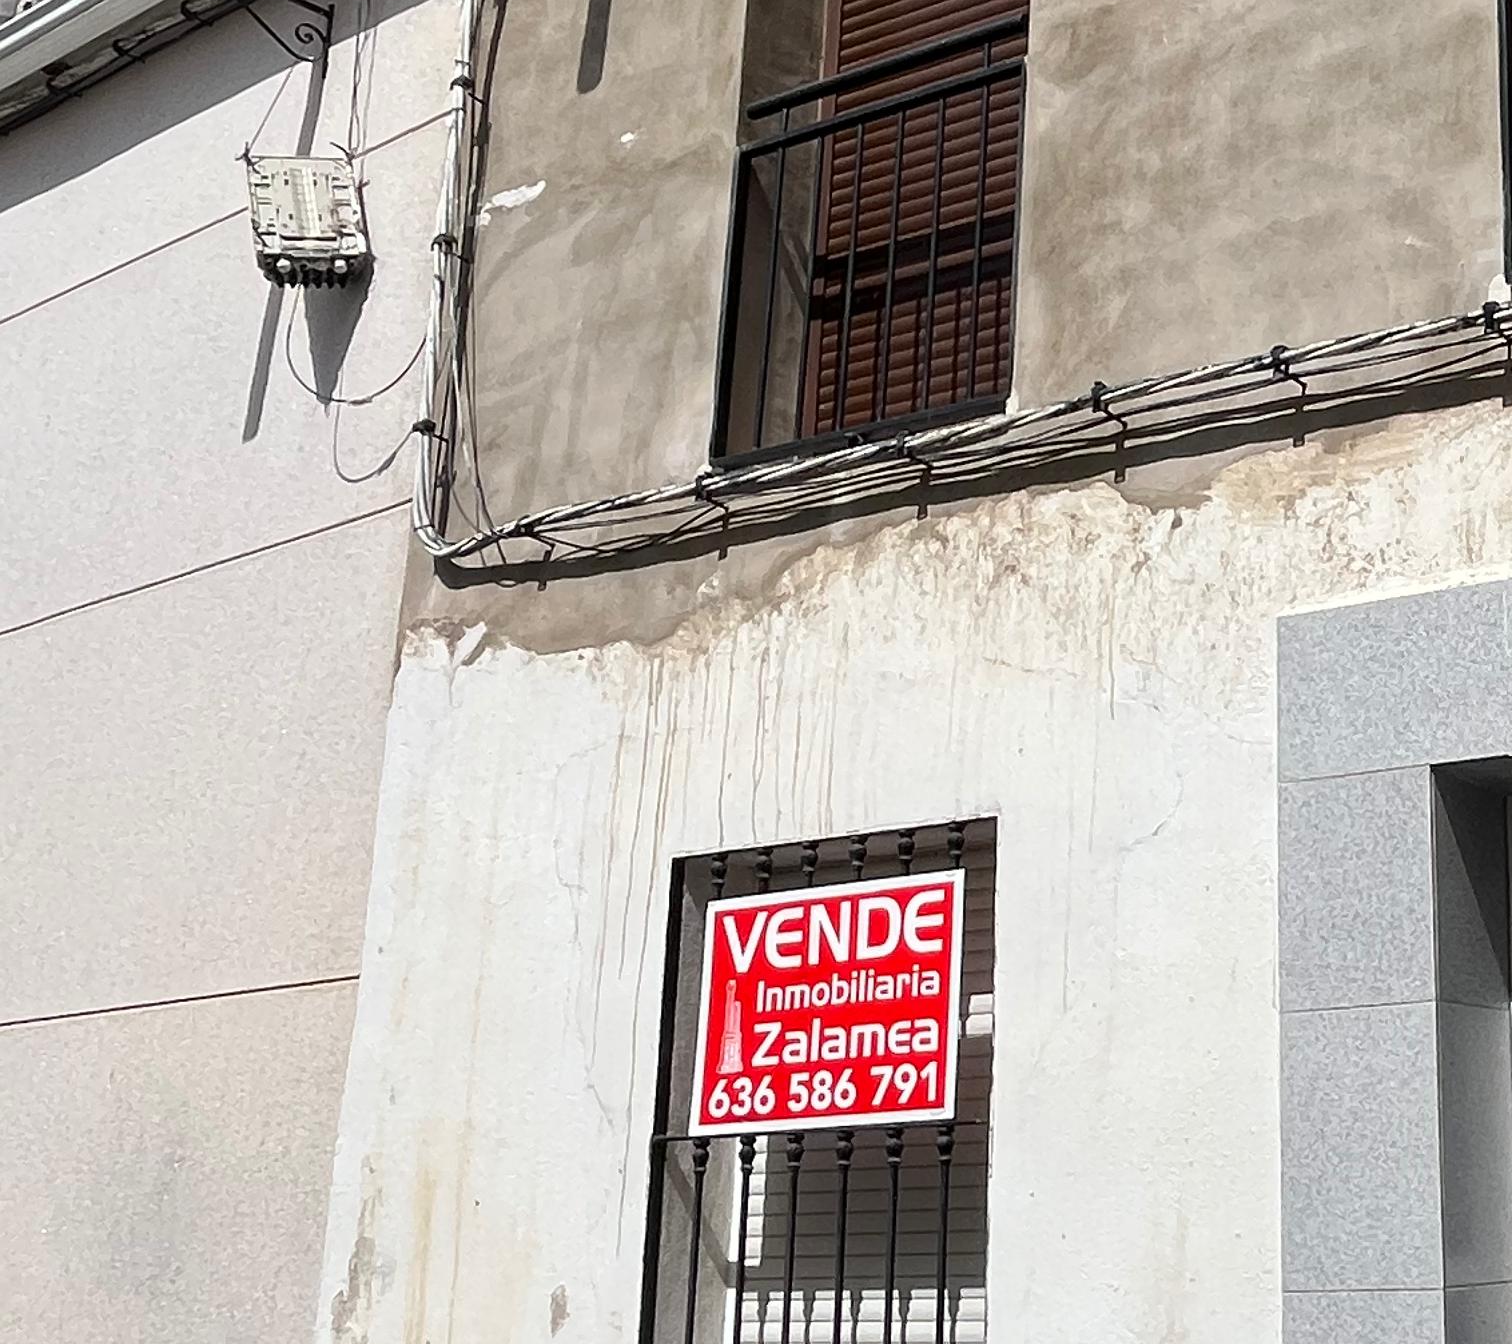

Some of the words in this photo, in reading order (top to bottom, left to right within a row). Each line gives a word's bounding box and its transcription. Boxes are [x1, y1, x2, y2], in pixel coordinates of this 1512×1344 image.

[723, 889, 946, 973] VENDE
[756, 964, 941, 1013] Inmobiliaria
[751, 1017, 940, 1067] Zalamea
[708, 1075, 776, 1118] 636
[787, 1069, 857, 1112] 586
[870, 1061, 938, 1105] 791
